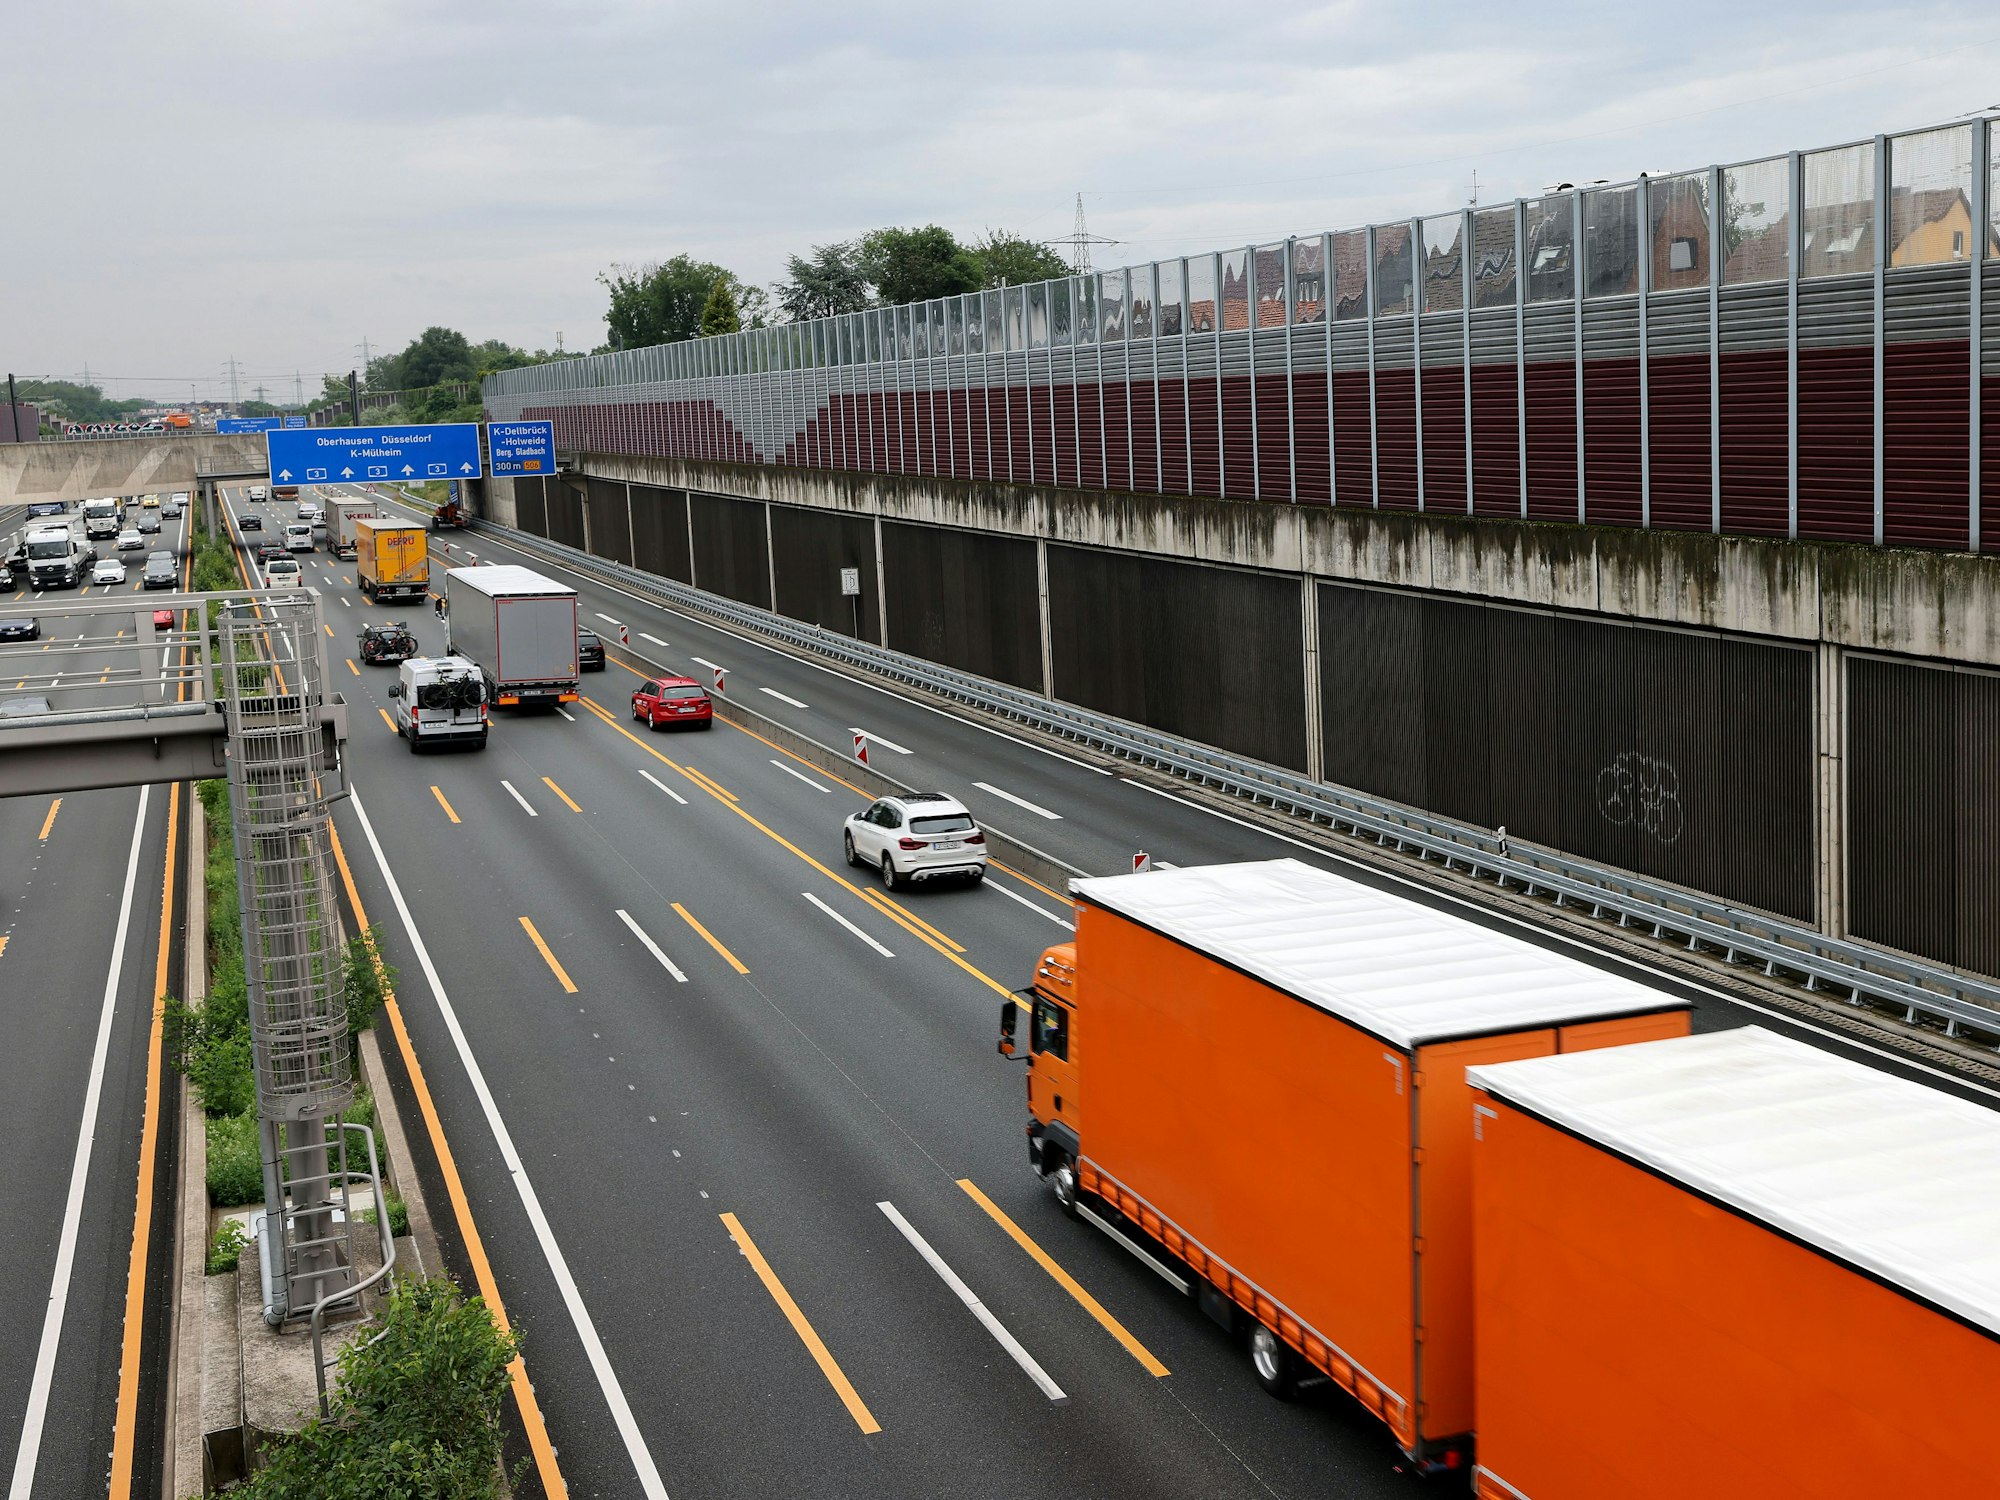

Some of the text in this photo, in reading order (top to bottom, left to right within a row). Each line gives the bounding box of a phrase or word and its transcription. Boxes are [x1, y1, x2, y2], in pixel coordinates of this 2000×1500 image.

[493, 426, 547, 436] K-Dellbrück
[317, 434, 432, 446] Oberhausen Düsseldorf
[501, 437, 546, 445] -Holweide
[350, 448, 402, 458] K-Mülheim
[496, 447, 546, 458] Berg. Gladbach
[434, 465, 440, 473] 3
[495, 462, 511, 470] 300
[314, 470, 320, 478] 3
[375, 467, 381, 475] 3
